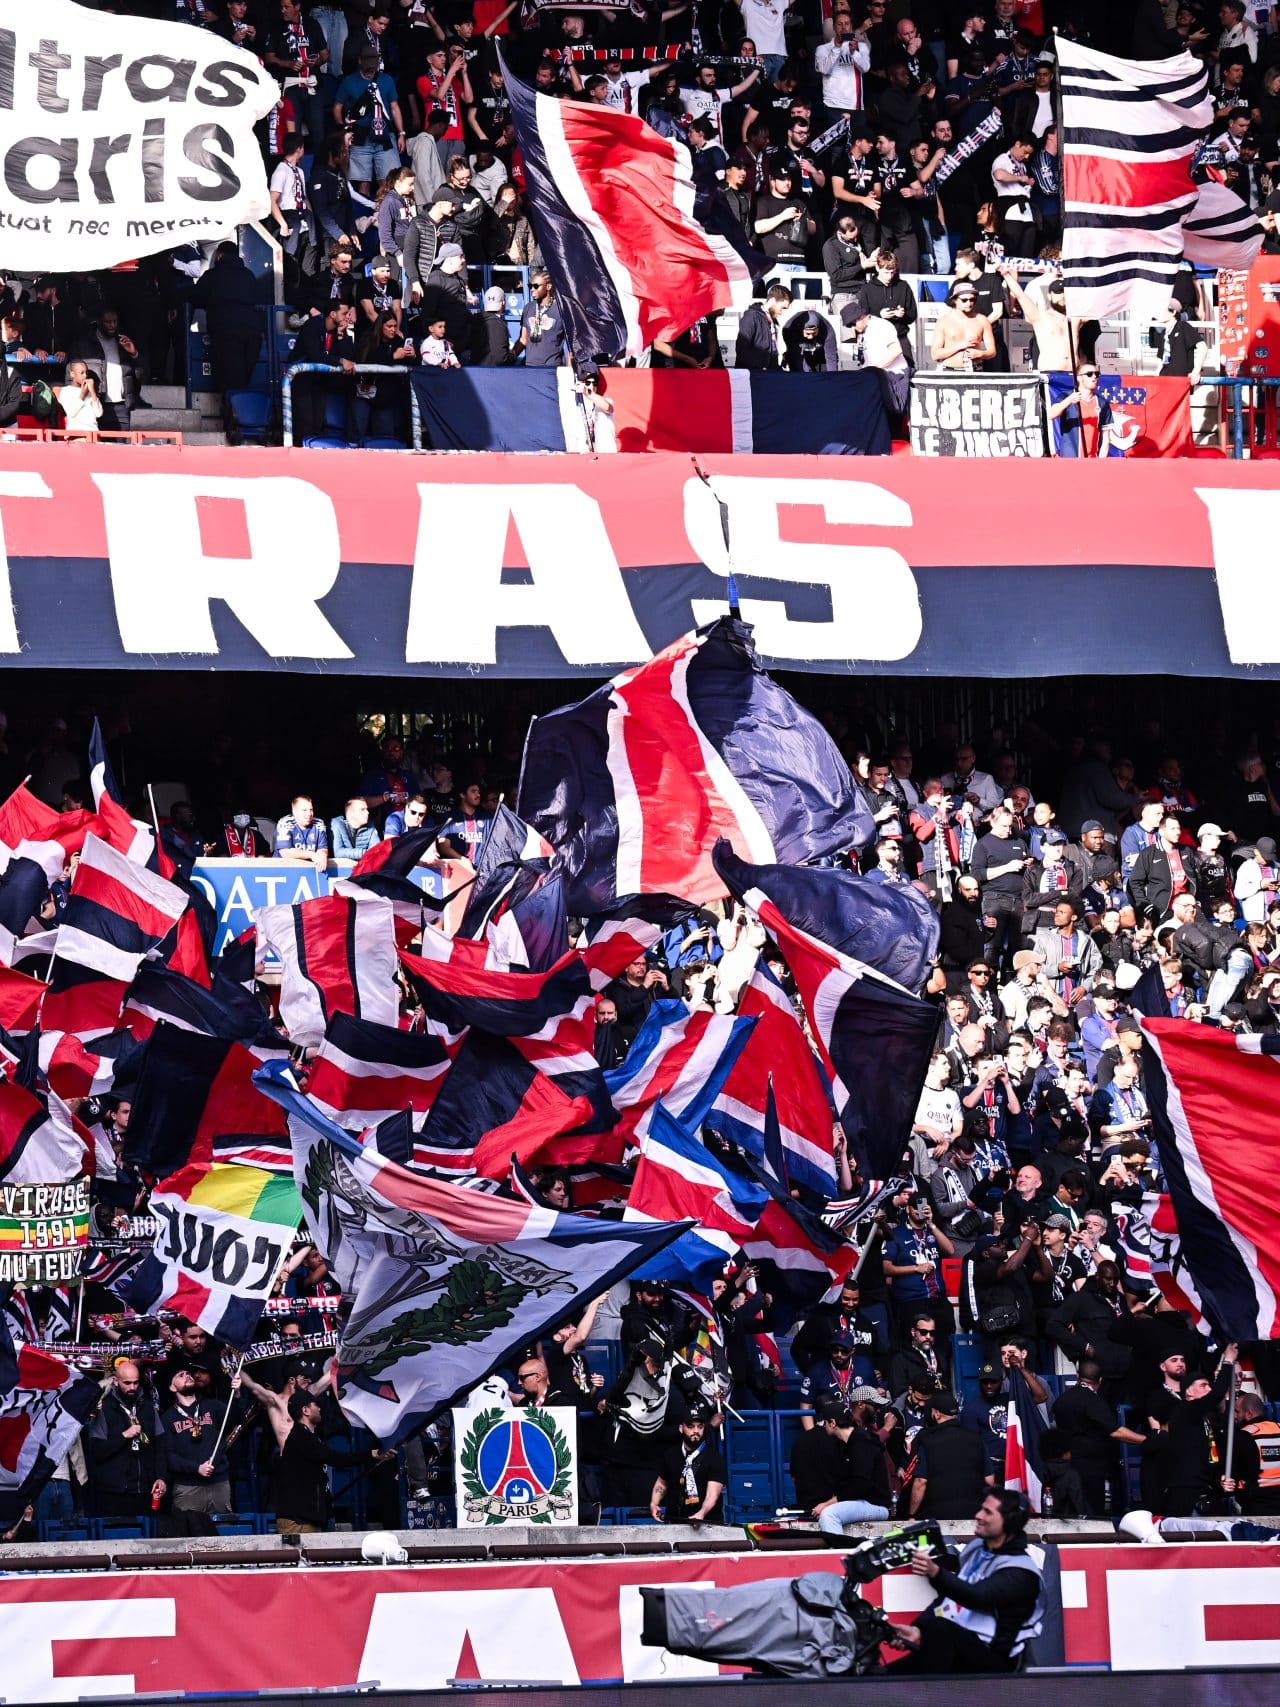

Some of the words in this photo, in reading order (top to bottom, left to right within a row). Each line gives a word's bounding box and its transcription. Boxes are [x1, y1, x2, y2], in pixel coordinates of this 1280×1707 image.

[68, 217, 110, 237] nec
[911, 387, 1042, 430] LIBEREZ
[911, 427, 940, 457] LE
[19, 1218, 76, 1250] 1991
[498, 1503, 539, 1517] PARIS
